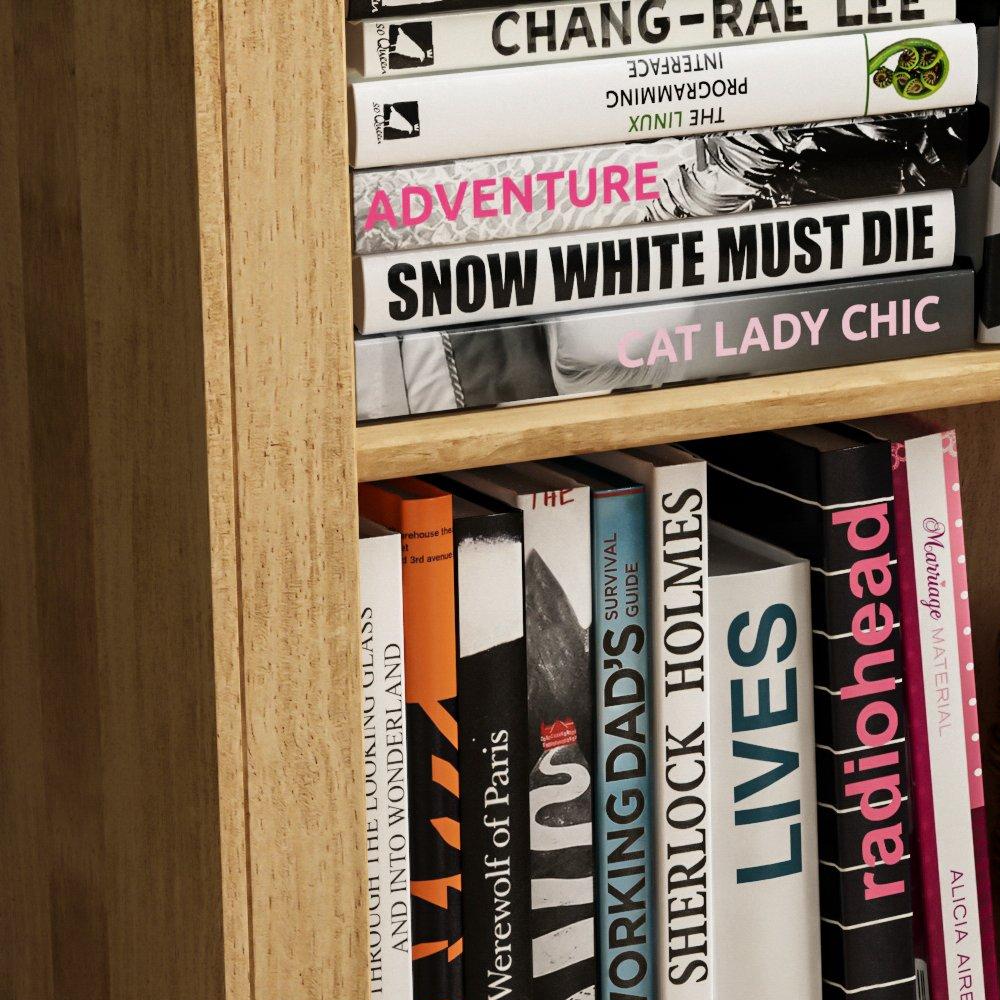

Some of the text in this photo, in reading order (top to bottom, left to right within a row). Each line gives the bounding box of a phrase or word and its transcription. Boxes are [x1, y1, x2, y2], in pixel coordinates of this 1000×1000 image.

[606, 77, 748, 108] PROGRAMMING
[627, 52, 723, 78] INTERFACE
[628, 107, 725, 132] THE LINUX
[364, 161, 660, 231] ADVENTURE
[387, 204, 934, 322] SNOW WHITE MUST DIE
[617, 295, 941, 369] CAT LADY CHIC
[605, 532, 618, 620] SURVIVAL
[626, 562, 639, 617] GUIDE
[920, 517, 952, 737] Marriage MATERIAL
[662, 488, 709, 985] SHERLOCK HOLMES
[832, 503, 905, 900] radiohead
[482, 729, 510, 808] Paris
[727, 603, 802, 884] LIVES
[384, 643, 408, 953] AND INTO WONDERLAND
[484, 815, 511, 849] of
[950, 870, 968, 944] ALICIA
